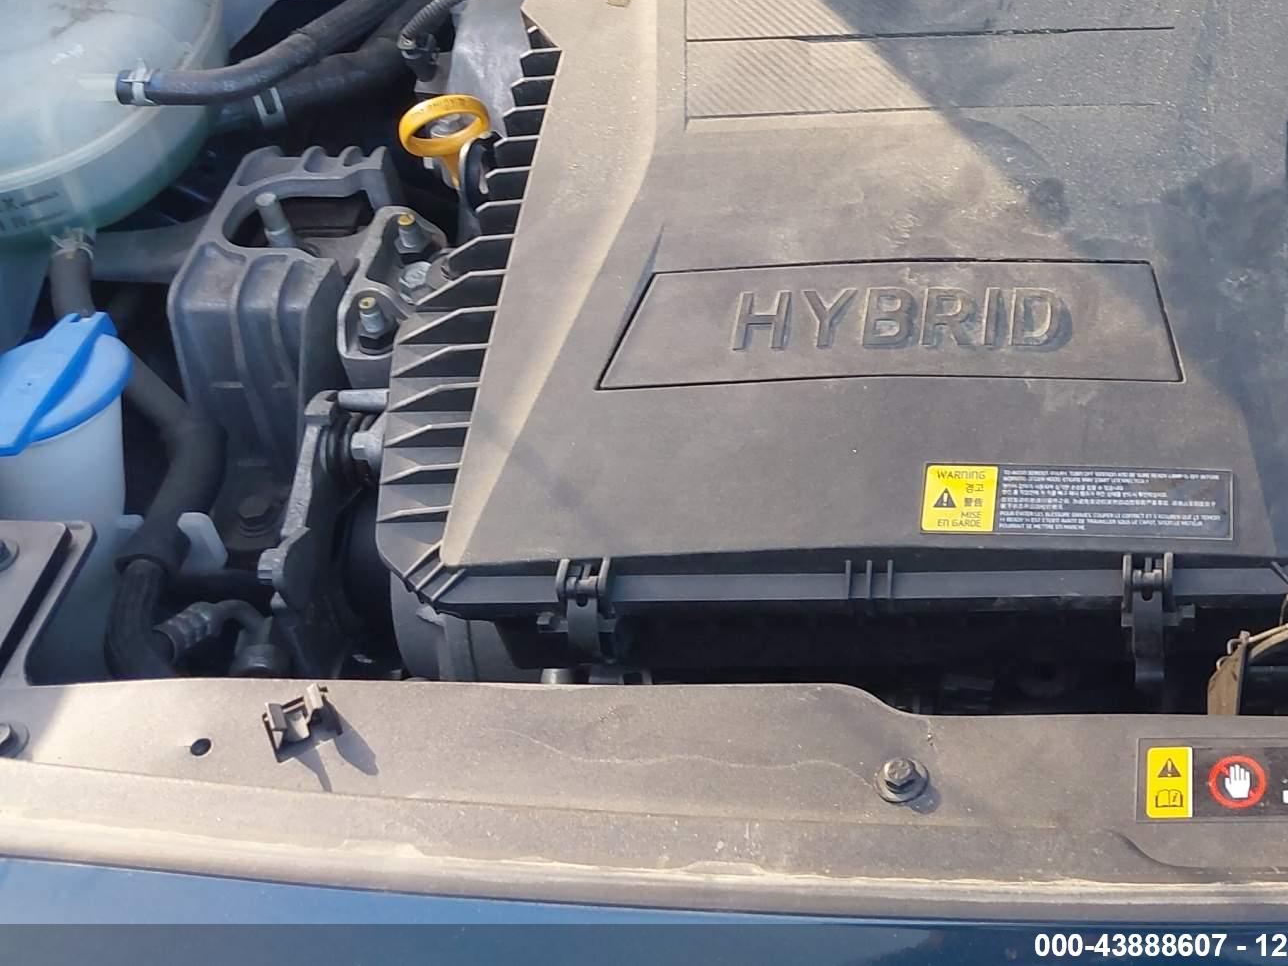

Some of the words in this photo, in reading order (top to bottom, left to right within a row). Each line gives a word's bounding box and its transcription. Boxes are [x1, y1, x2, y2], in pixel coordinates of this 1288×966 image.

[732, 286, 1072, 351] HYBRID
[936, 470, 986, 480] WARNING
[960, 511, 982, 519] MISE
[937, 519, 949, 527] EN
[951, 518, 982, 527] GARDE
